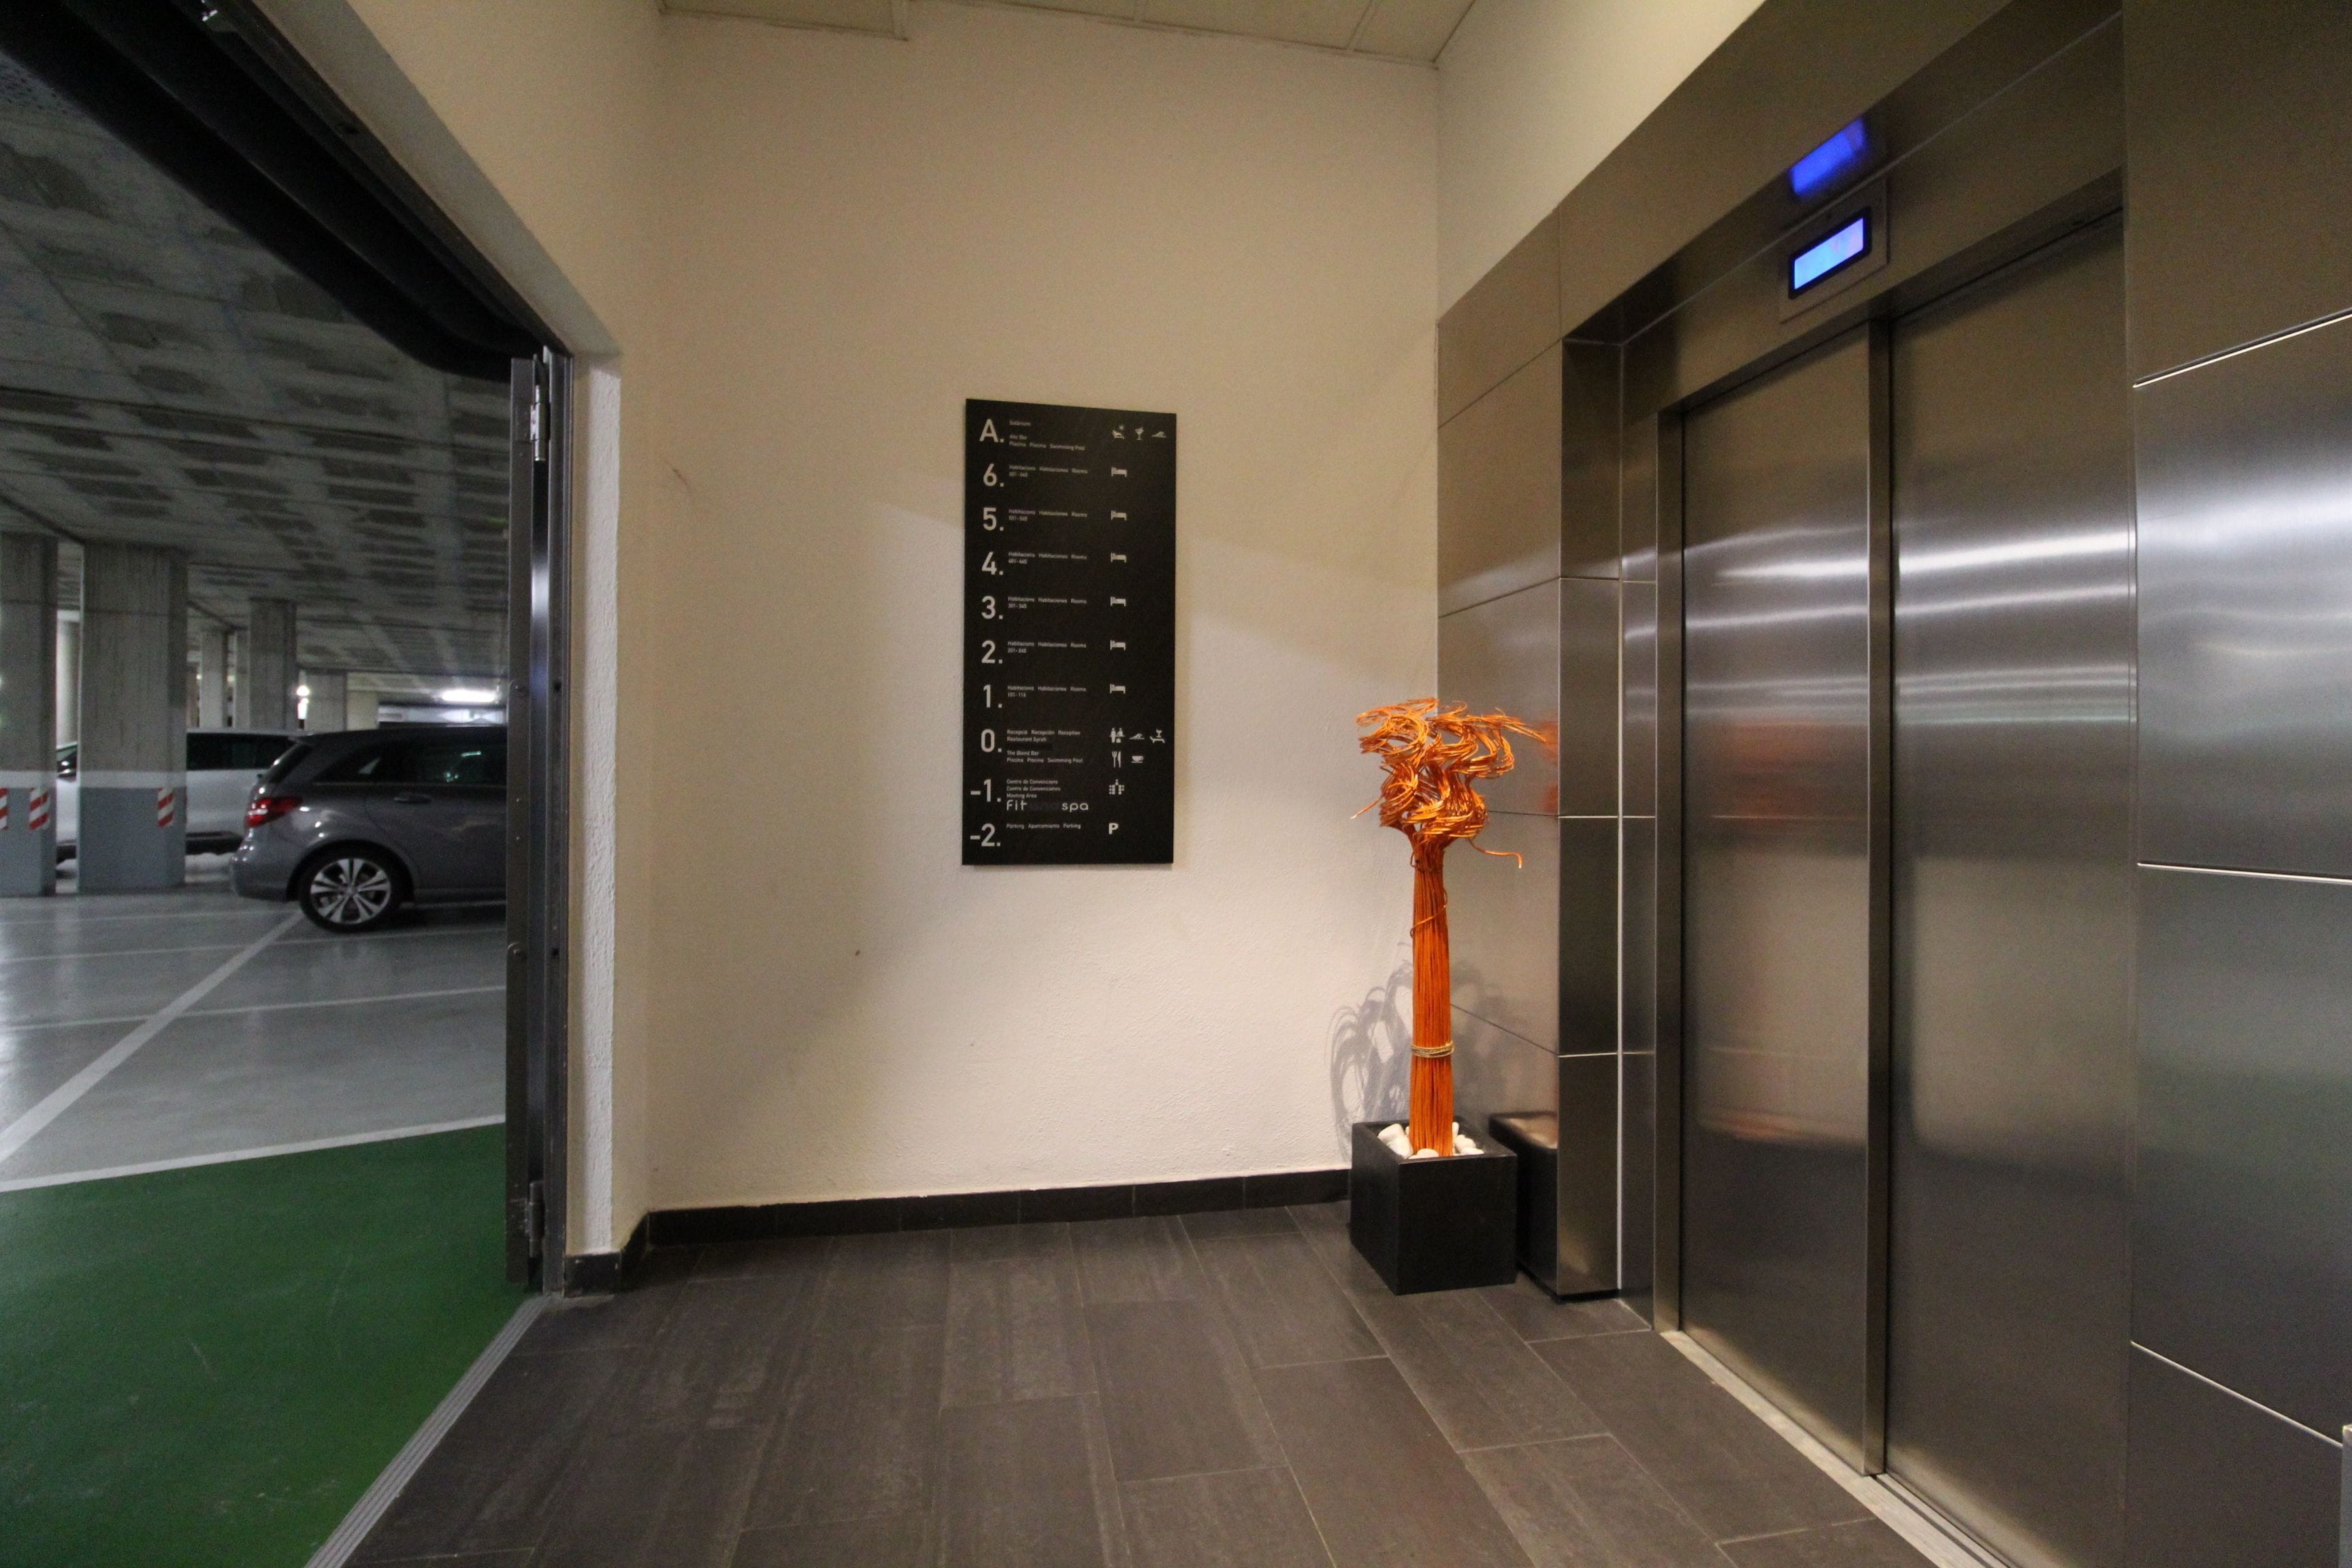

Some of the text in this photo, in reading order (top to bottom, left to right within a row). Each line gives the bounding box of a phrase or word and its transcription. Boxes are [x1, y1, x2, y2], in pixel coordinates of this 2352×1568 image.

[979, 419, 1004, 443] A.
[1049, 443, 1074, 451] Swimming
[983, 463, 1004, 487] 6.
[983, 507, 1004, 532] 5.
[981, 551, 1004, 576] 4.
[981, 595, 1003, 620] 3.
[981, 640, 1002, 664] 2.
[983, 684, 1002, 708] 1.
[981, 729, 1002, 753] 0.
[1062, 802, 1089, 813] spa
[1109, 823, 1119, 835] P
